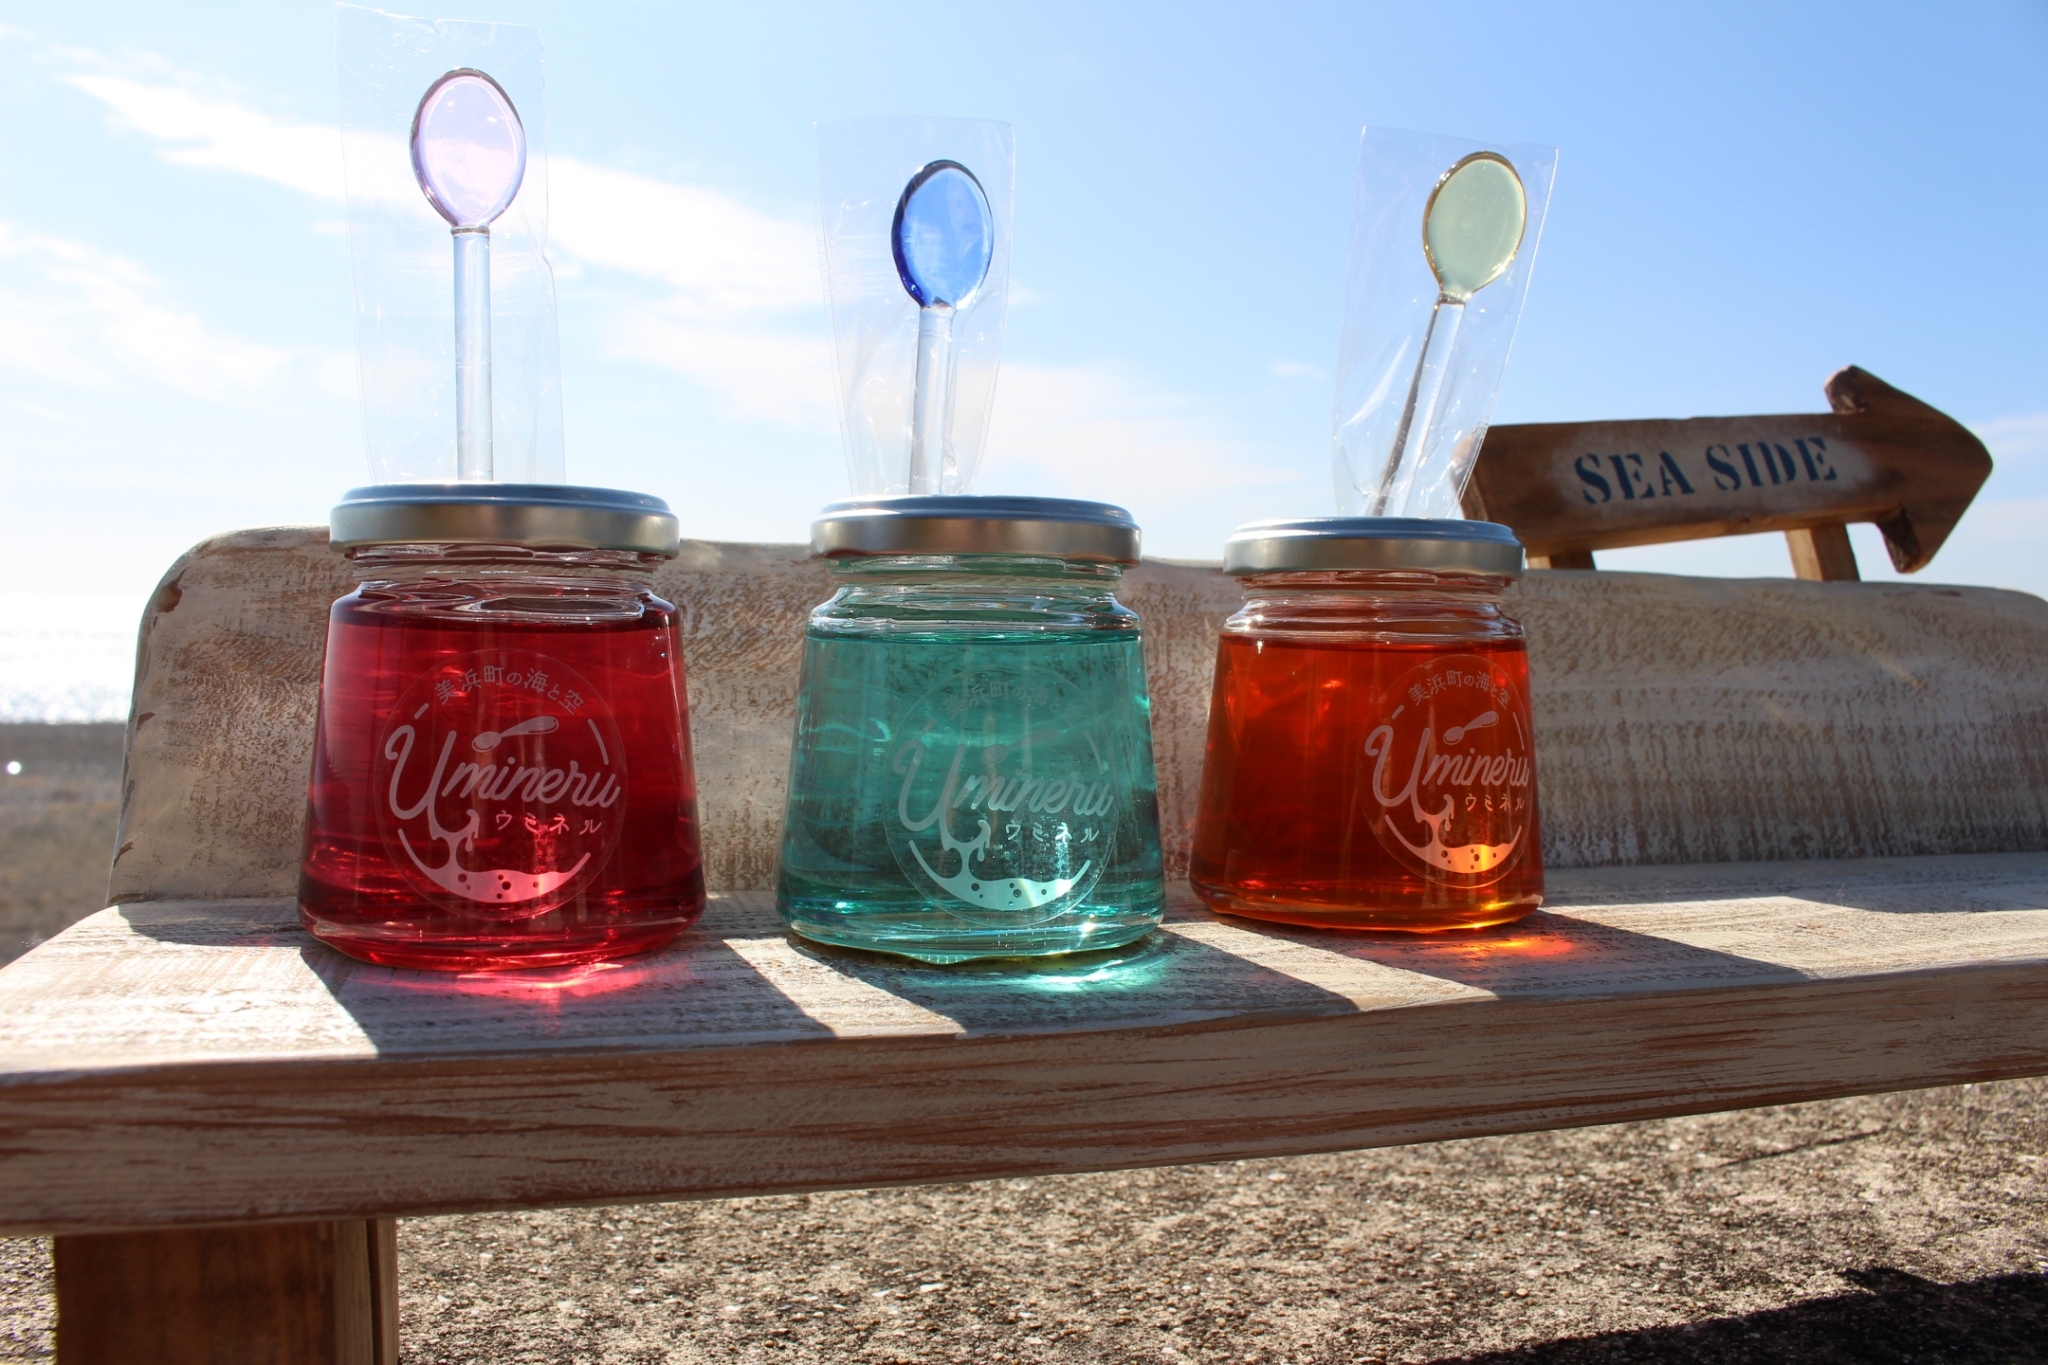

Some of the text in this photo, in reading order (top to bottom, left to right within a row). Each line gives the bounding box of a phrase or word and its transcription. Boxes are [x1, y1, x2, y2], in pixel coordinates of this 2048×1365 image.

[1574, 437, 1837, 504] SEA SIDE
[435, 665, 584, 716] 美浜町の海と空
[1408, 670, 1511, 710] 美浜町の海と空
[385, 724, 621, 822] Umineru
[893, 738, 1114, 833] Umineru
[1364, 725, 1530, 809] Umineru
[495, 809, 602, 835] ウミネル
[1465, 793, 1526, 812] ウミネル
[1005, 821, 1100, 844] ウミネル
